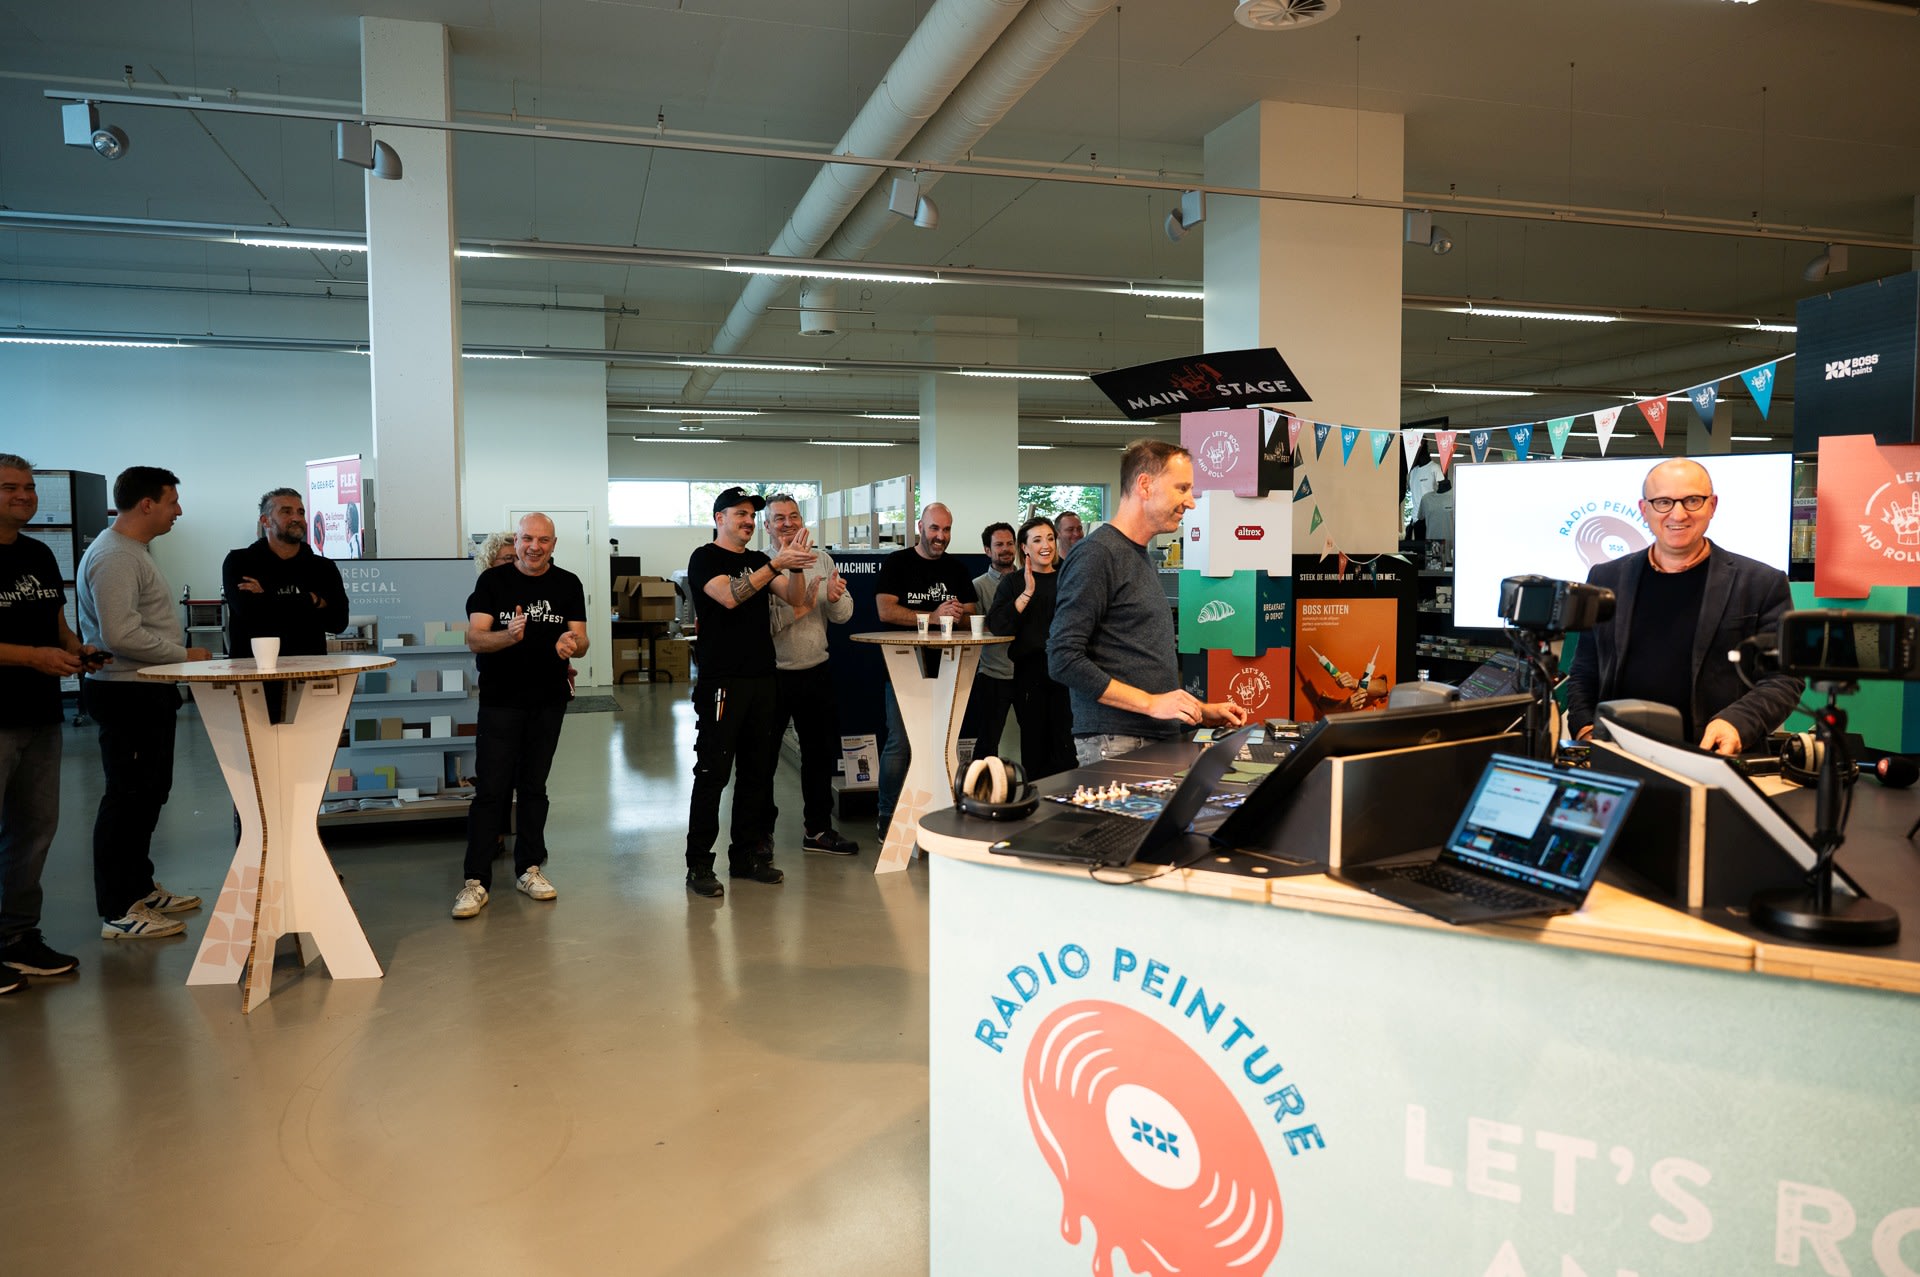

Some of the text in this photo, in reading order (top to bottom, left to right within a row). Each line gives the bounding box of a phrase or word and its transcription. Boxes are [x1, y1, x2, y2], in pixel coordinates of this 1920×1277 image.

[1852, 354, 1879, 368] BOSS
[1852, 366, 1873, 377] paints
[1127, 380, 1291, 410] MAIN STAGE
[1212, 430, 1240, 453] LET'S ROCK
[1198, 458, 1224, 478] AND ROLL
[340, 473, 357, 488] FLEX
[1896, 471, 1920, 484] LET
[1559, 502, 1597, 536] RADIO
[1238, 527, 1261, 536] altrex
[1858, 524, 1883, 550] AND
[342, 567, 380, 579] REND
[836, 562, 876, 574] MACHINE
[36, 588, 59, 599] FEST
[343, 581, 397, 593] PECIAL
[907, 592, 931, 601] PAINT
[1263, 603, 1285, 612] BREAKFAST
[1302, 604, 1349, 615] BOSS KITTEN
[499, 611, 564, 624] PAIT FEST
[1270, 612, 1284, 620] DEPOT
[1241, 667, 1271, 690] LET'S ROCK
[974, 943, 1327, 1157] RADIO PEINTURE
[1404, 1103, 1714, 1244] LET'S
